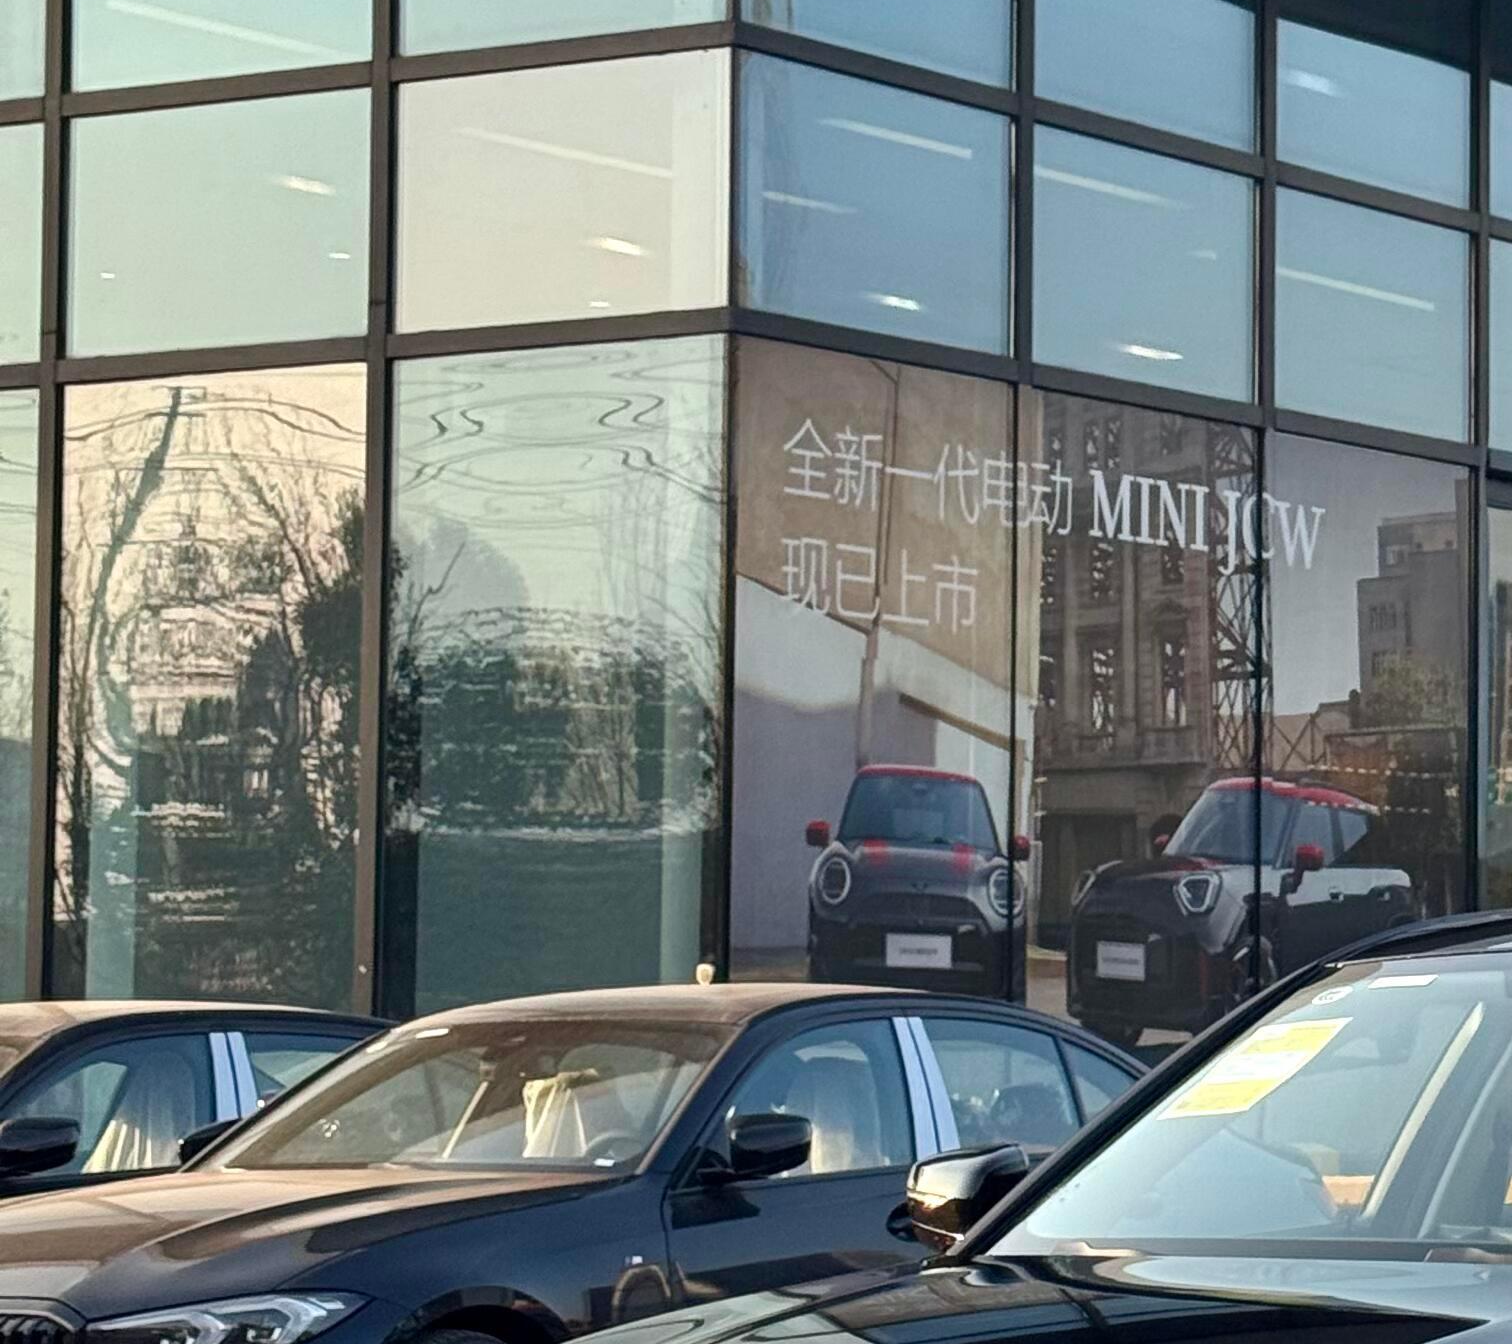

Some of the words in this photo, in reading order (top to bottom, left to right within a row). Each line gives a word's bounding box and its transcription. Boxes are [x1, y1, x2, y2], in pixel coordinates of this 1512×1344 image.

[783, 418, 1073, 536] 全新一代电动
[1088, 469, 1210, 552] MINI
[1217, 490, 1326, 571] JCW
[781, 536, 979, 634] 现已上市
